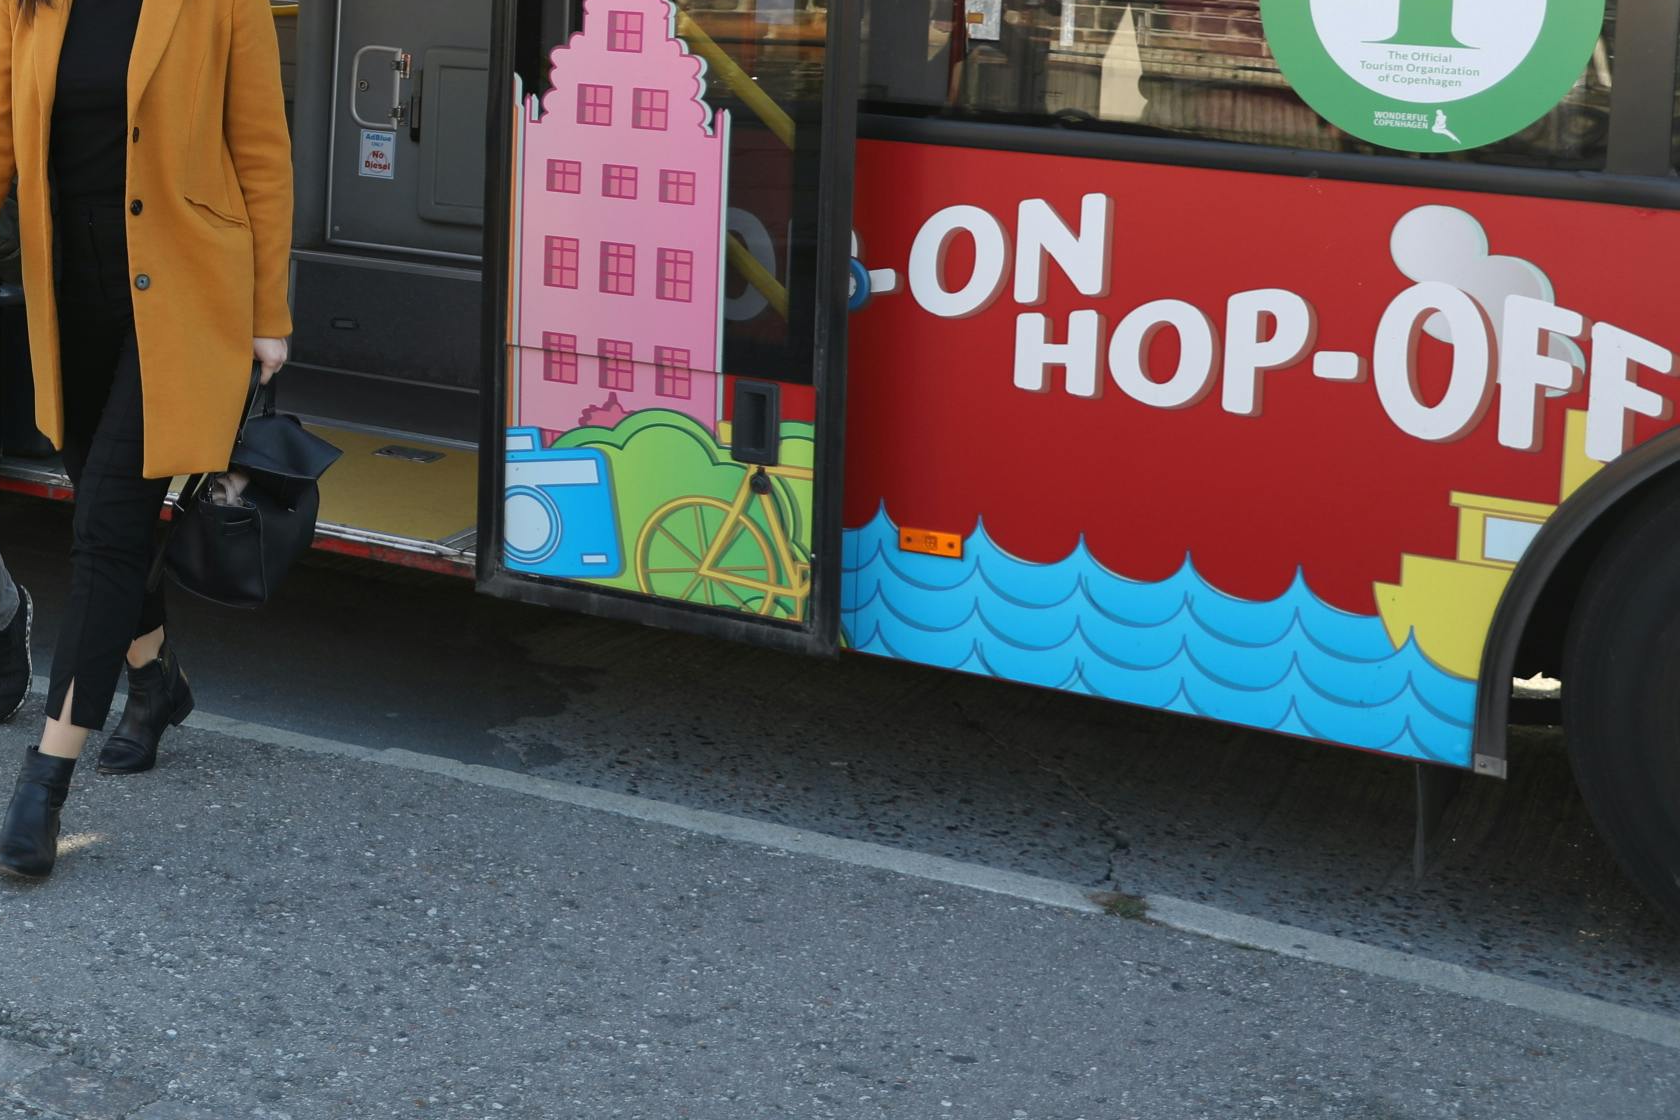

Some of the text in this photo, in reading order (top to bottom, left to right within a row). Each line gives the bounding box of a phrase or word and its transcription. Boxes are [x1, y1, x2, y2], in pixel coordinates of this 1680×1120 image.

[1388, 50, 1453, 63] The Official
[1359, 60, 1480, 77] Tourism Organization
[1377, 73, 1462, 88] of Copenhagen
[1373, 111, 1429, 122] WONDERFUL
[1373, 119, 1429, 129] COPENHAGEN
[372, 150, 384, 159] No
[364, 160, 391, 170] Diesel
[851, 193, 1108, 318] -ON
[1013, 281, 1673, 462] HOP-OFF
